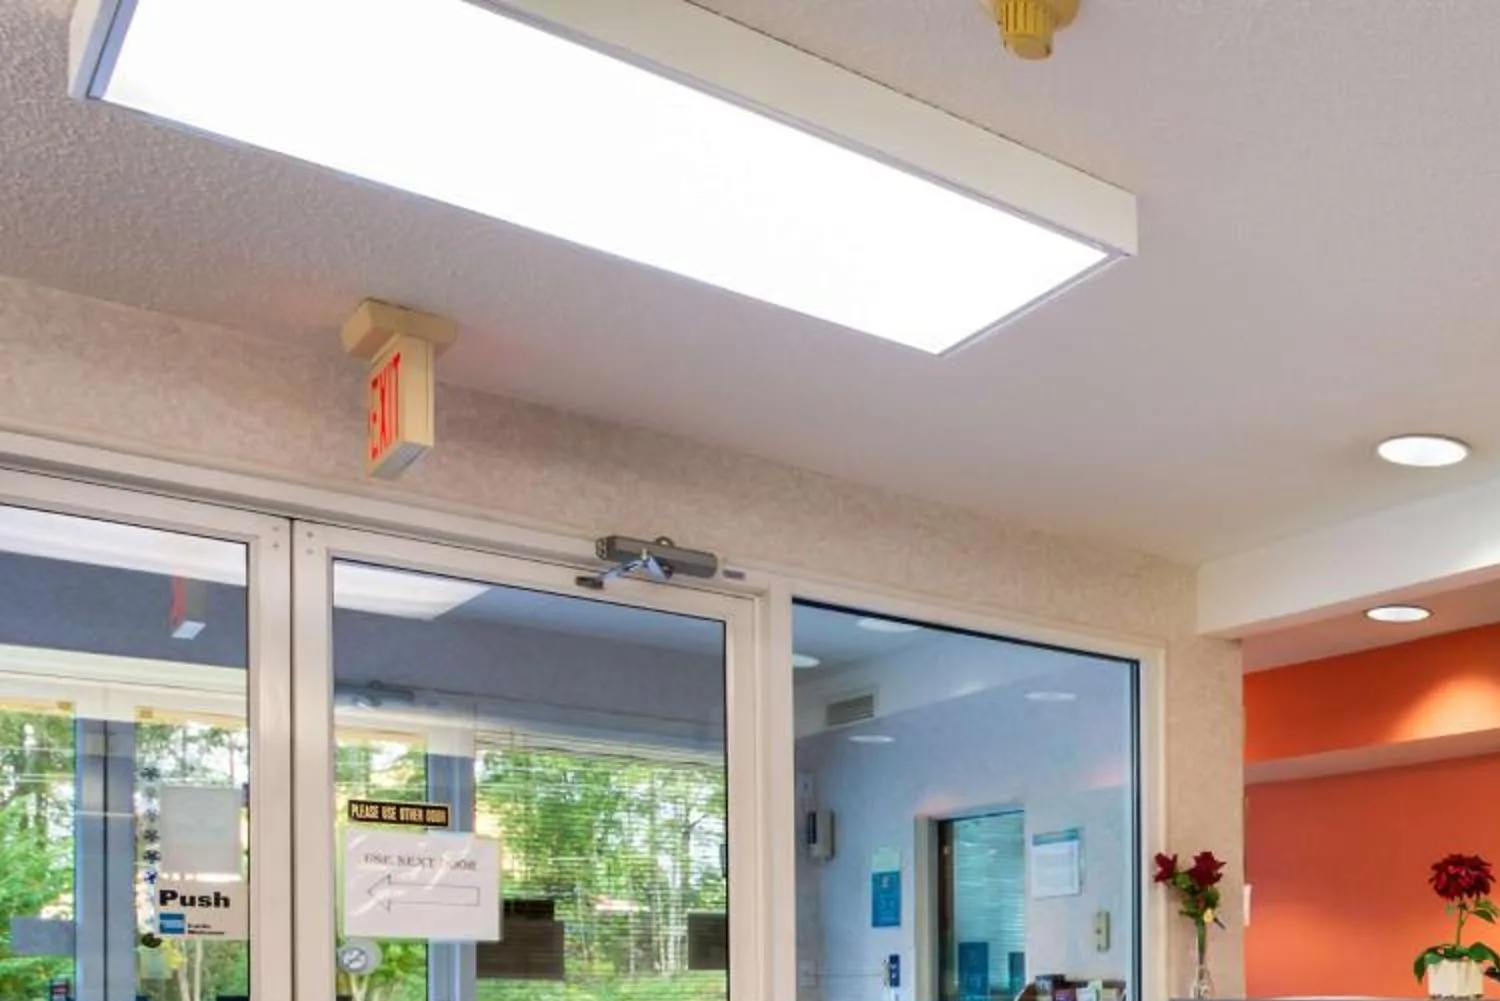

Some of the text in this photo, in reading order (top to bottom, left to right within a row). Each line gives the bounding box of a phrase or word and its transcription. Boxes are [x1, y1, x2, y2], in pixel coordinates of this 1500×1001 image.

[352, 803, 379, 818] PLEASE
[381, 806, 397, 821] USE
[400, 807, 424, 823] OTHER
[397, 855, 434, 868] NEXT
[160, 889, 230, 908] Push
